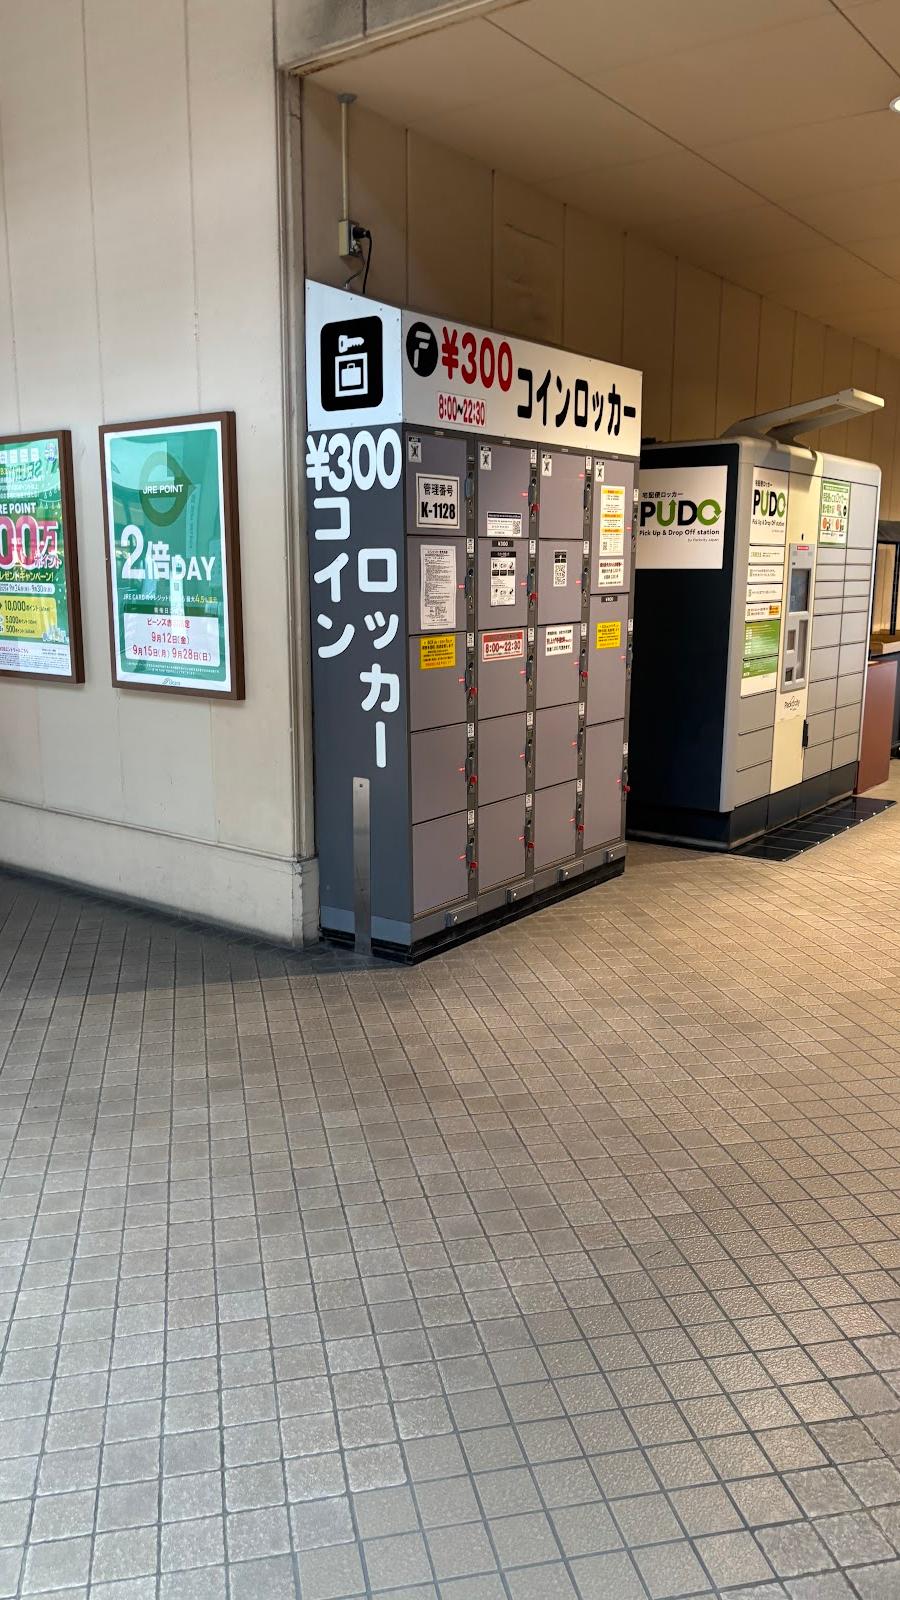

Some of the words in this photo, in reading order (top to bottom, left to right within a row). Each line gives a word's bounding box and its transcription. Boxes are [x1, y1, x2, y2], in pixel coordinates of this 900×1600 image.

[442, 326, 513, 392] ¥300
[517, 368, 636, 436] コインロッカー
[306, 428, 402, 492] ¥300
[143, 485, 158, 494] JRE
[159, 484, 184, 494] POINT
[423, 483, 453, 497] 管理番号
[642, 491, 684, 499] 宅配便ロッカー
[9, 502, 36, 514] POINT
[421, 501, 456, 520] K-1128
[639, 499, 722, 526] PUDO
[753, 489, 786, 518] PUDO
[120, 524, 216, 581] 2倍DAY
[313, 496, 355, 659] コイン
[151, 631, 190, 645] 9月12日(金)
[132, 644, 170, 658] 9月15日(月)
[172, 647, 212, 662] 9月28日(日)
[357, 548, 400, 768] ロッカー
